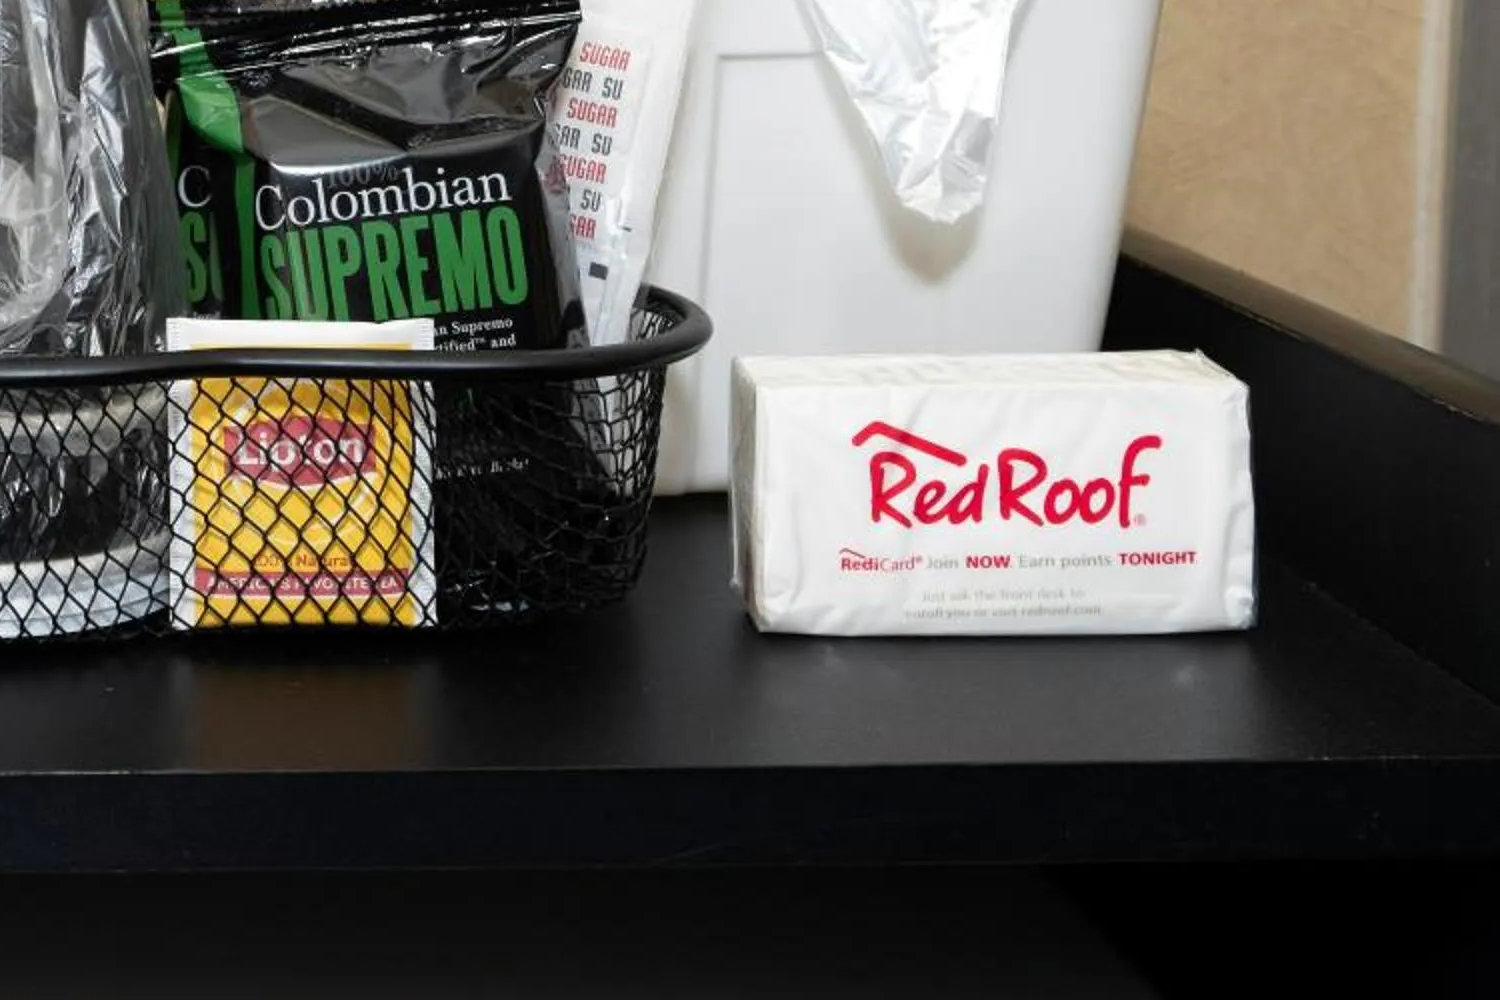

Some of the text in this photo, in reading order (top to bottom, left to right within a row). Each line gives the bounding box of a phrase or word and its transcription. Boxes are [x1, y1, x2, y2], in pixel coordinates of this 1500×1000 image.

[580, 41, 631, 71] SUGAR
[601, 76, 624, 100] SU
[567, 97, 617, 129] SUGAR
[591, 133, 613, 157] SU
[560, 154, 608, 185] SUGAR
[254, 165, 512, 231] Colombian
[260, 206, 528, 324] SUPREMO
[451, 318, 514, 336] Supremo
[491, 333, 517, 349] and
[927, 554, 959, 571] Join
[1019, 554, 1056, 569] Earn
[1060, 553, 1112, 570] points
[1117, 550, 1197, 566] TONIGHT
